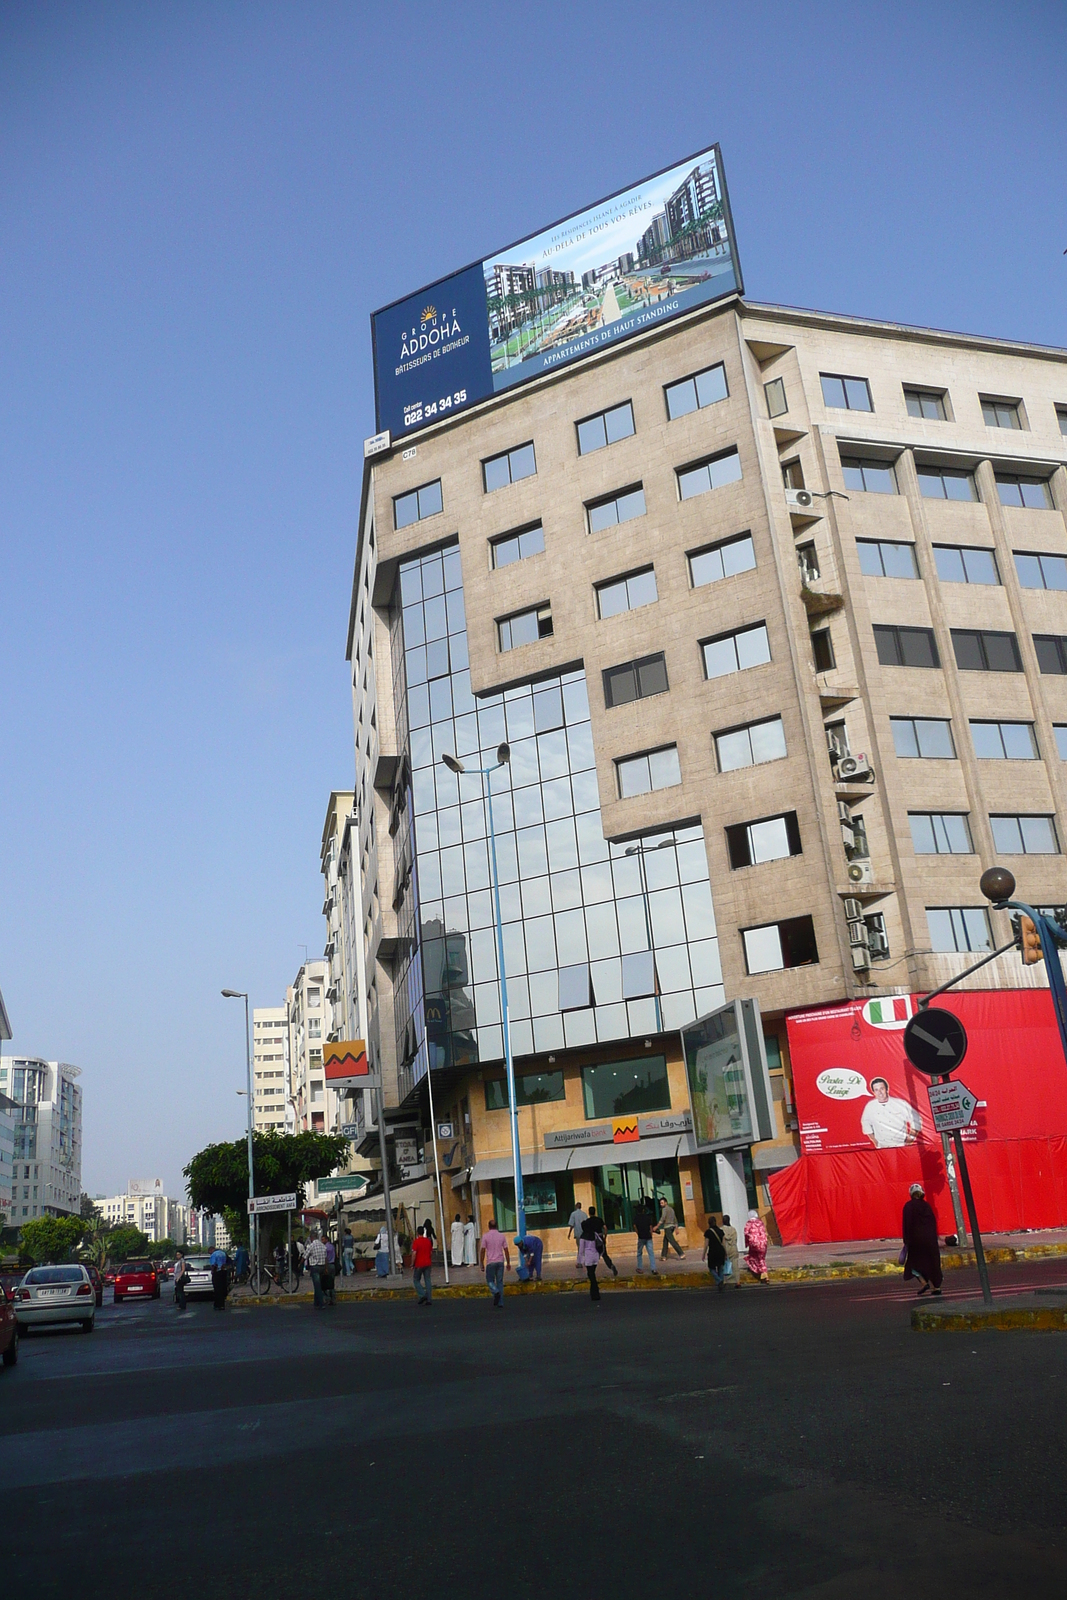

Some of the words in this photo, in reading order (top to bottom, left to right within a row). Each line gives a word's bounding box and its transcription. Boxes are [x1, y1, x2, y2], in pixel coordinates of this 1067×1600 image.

[619, 195, 642, 209] AGADIR
[542, 238, 574, 258] AU-DELÀ
[576, 231, 586, 242] DE
[589, 220, 609, 235] TOUS
[611, 212, 627, 224] VOS
[400, 319, 461, 359] ADDOHA
[543, 336, 599, 366] APPARTEMENTS
[601, 330, 612, 340] DE
[613, 319, 635, 334] HAUT
[637, 301, 679, 325] STANDING
[433, 347, 441, 358] DE
[442, 335, 470, 354] BONHEUR
[405, 409, 423, 426] 022
[425, 402, 437, 417] 34
[439, 395, 452, 411] 34
[454, 389, 467, 404] 35
[402, 448, 416, 459] C78
[819, 1075, 843, 1084] Pasta
[826, 1085, 850, 1097] Luigi
[344, 1127, 357, 1136] GFI
[554, 1129, 591, 1143] Attijariwafa
[592, 1129, 606, 1138] bank
